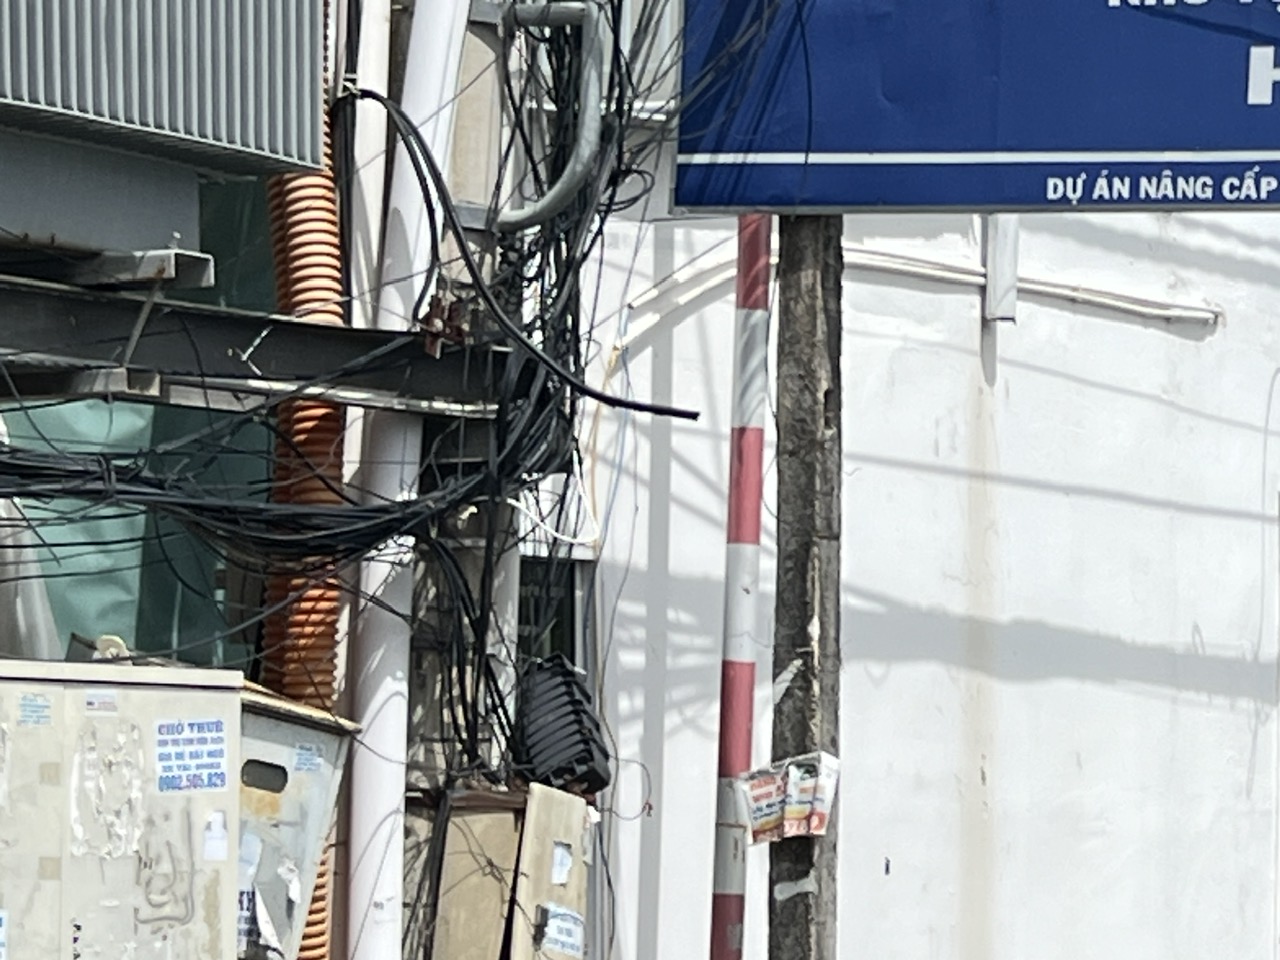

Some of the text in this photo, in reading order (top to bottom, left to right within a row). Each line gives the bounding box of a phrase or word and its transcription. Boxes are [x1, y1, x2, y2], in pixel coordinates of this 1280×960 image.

[1046, 172, 1087, 205] DỰ
[1092, 169, 1131, 200] ÁN
[1139, 169, 1214, 200] NÂNG
[1221, 165, 1278, 200] CẤP
